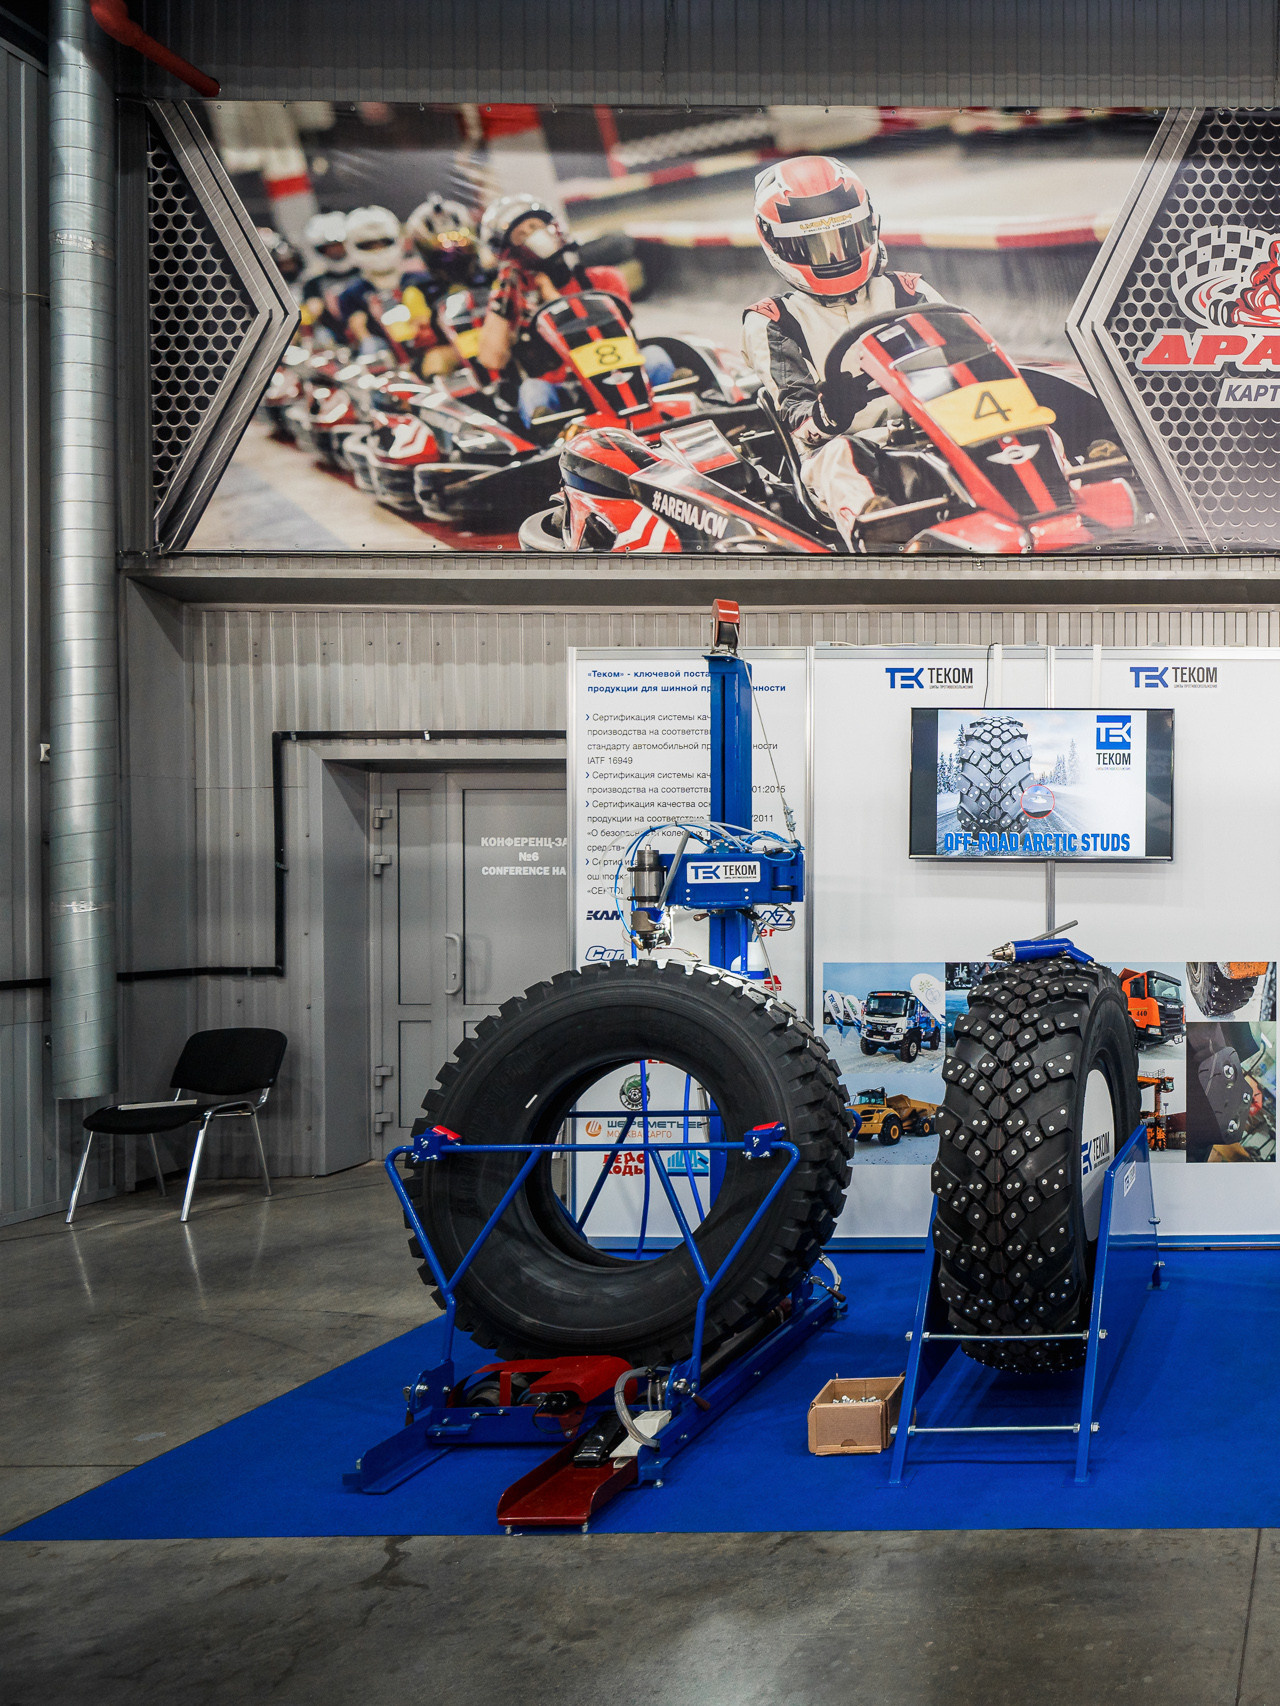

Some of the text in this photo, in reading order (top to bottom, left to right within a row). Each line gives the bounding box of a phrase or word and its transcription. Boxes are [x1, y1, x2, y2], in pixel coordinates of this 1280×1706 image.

[594, 344, 621, 367] 8
[974, 391, 1013, 422] 4
[652, 490, 728, 539] #ARENAJCW
[587, 669, 624, 678] «Теком»
[633, 669, 680, 678] ключевой
[928, 668, 973, 684] ТЕКОМ
[1172, 666, 1218, 682] ТЕКОМ
[587, 685, 638, 694] продукции
[640, 685, 657, 694] для
[660, 684, 697, 692] шинной
[592, 713, 655, 723] Сертификация
[587, 729, 646, 738] производства
[587, 743, 630, 752] стандарту
[632, 742, 698, 750] автомобильной
[587, 756, 633, 765] IATF 16949
[592, 771, 655, 781] Сертификация
[587, 786, 646, 795] производства
[591, 799, 654, 810] Сертификация
[586, 815, 632, 824] продукции
[481, 837, 567, 848] КОНФЕРЕНЦ-ЗА
[944, 831, 1130, 852] OFF-ROAD ARCTIC STUDS
[518, 852, 539, 862] №6
[482, 866, 566, 876] CONFERENCE HA
[1082, 1139, 1092, 1176] ЕК
